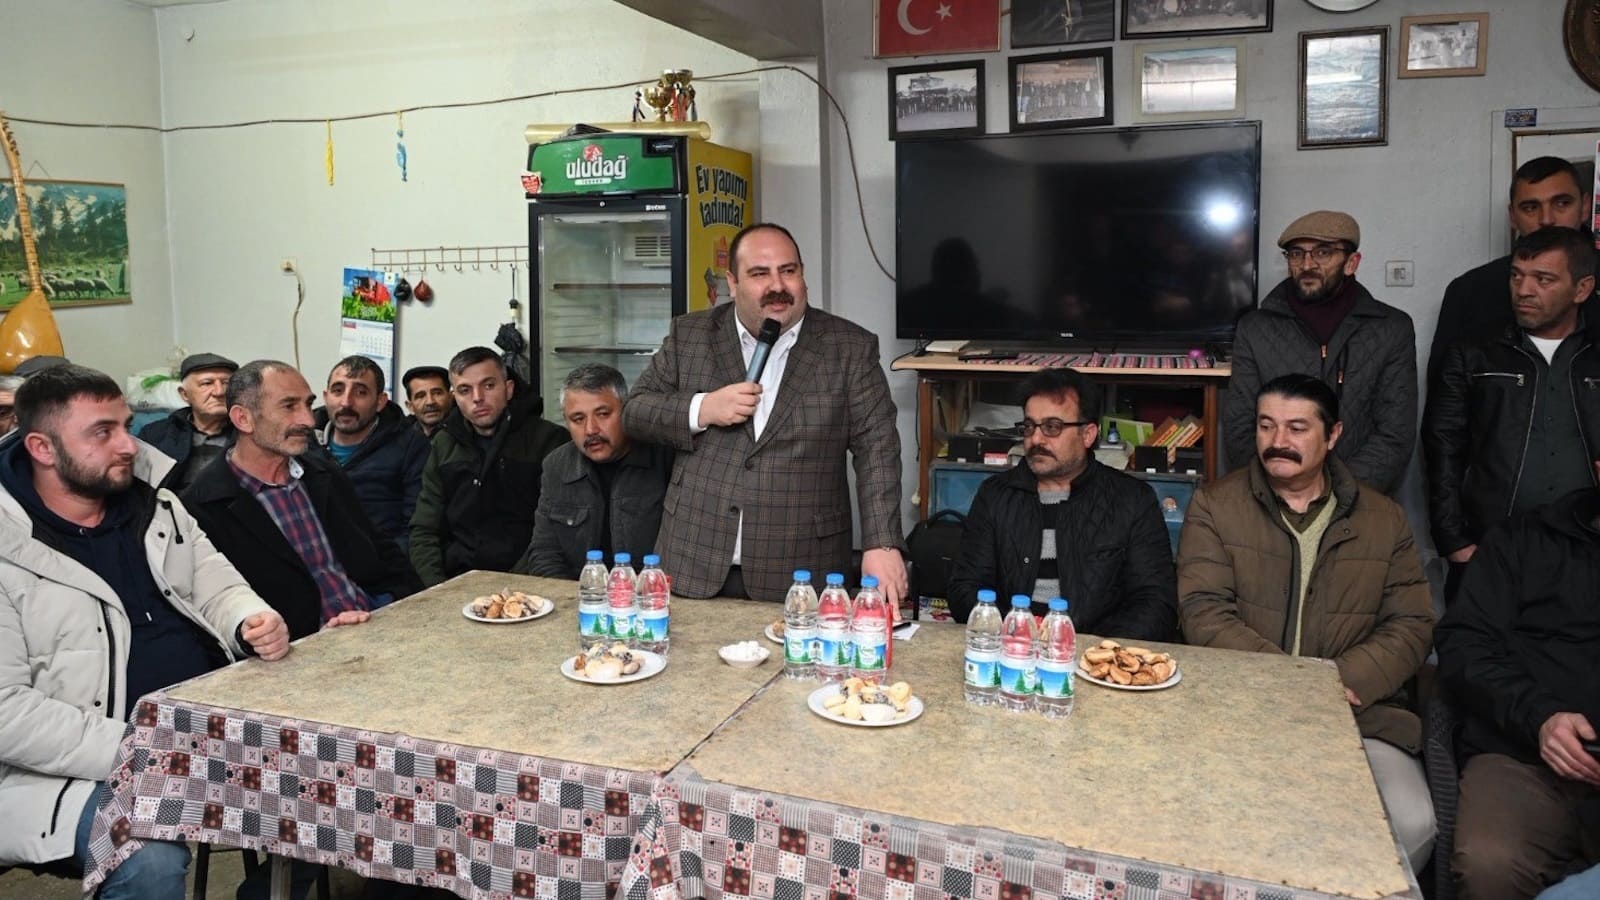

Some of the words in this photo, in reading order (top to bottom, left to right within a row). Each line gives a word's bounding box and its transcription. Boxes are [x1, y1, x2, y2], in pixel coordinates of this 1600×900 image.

[566, 154, 626, 179] uludağ
[696, 165, 709, 194] Ev
[713, 167, 748, 200] yapımı
[700, 196, 745, 228] tadında!
